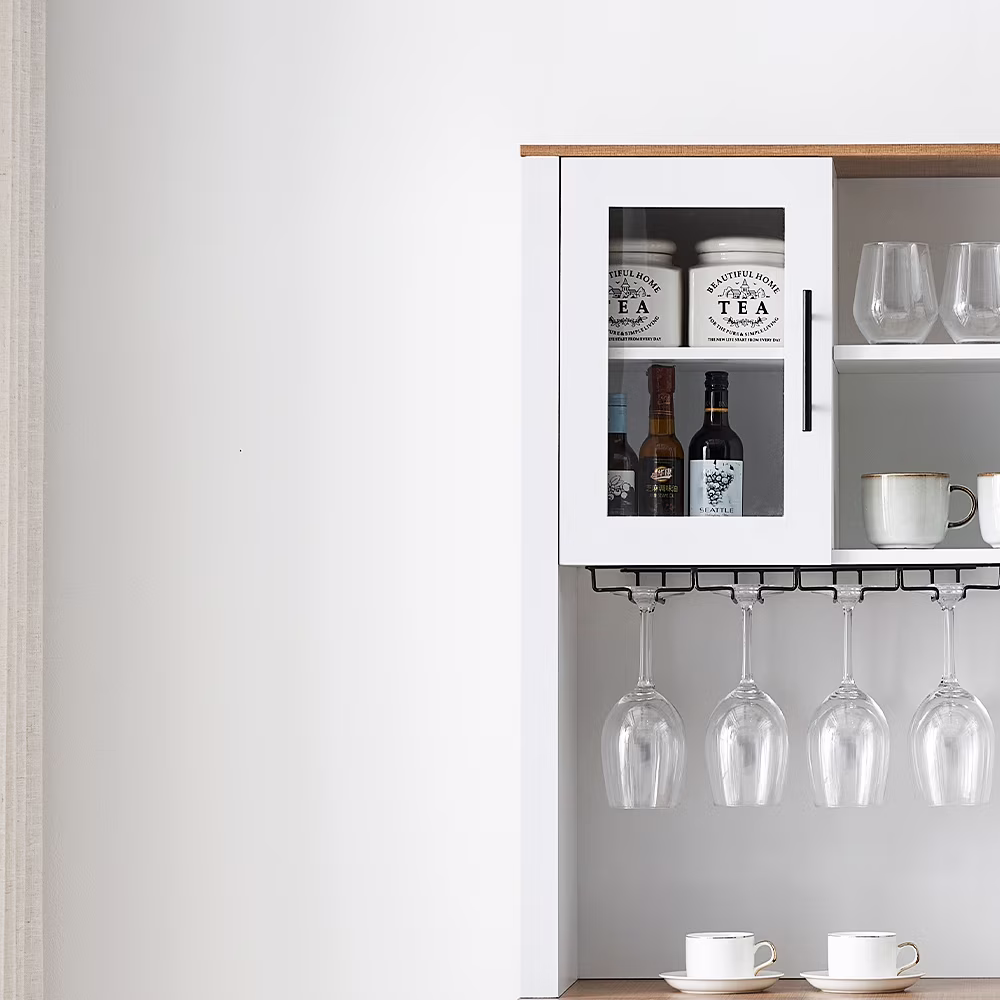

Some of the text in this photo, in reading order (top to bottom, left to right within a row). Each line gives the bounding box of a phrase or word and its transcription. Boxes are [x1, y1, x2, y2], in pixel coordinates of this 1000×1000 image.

[636, 272, 661, 293] HOME
[706, 270, 780, 294] BEAUTIFUL HOME
[609, 300, 649, 314] EA
[718, 300, 769, 315] TEA
